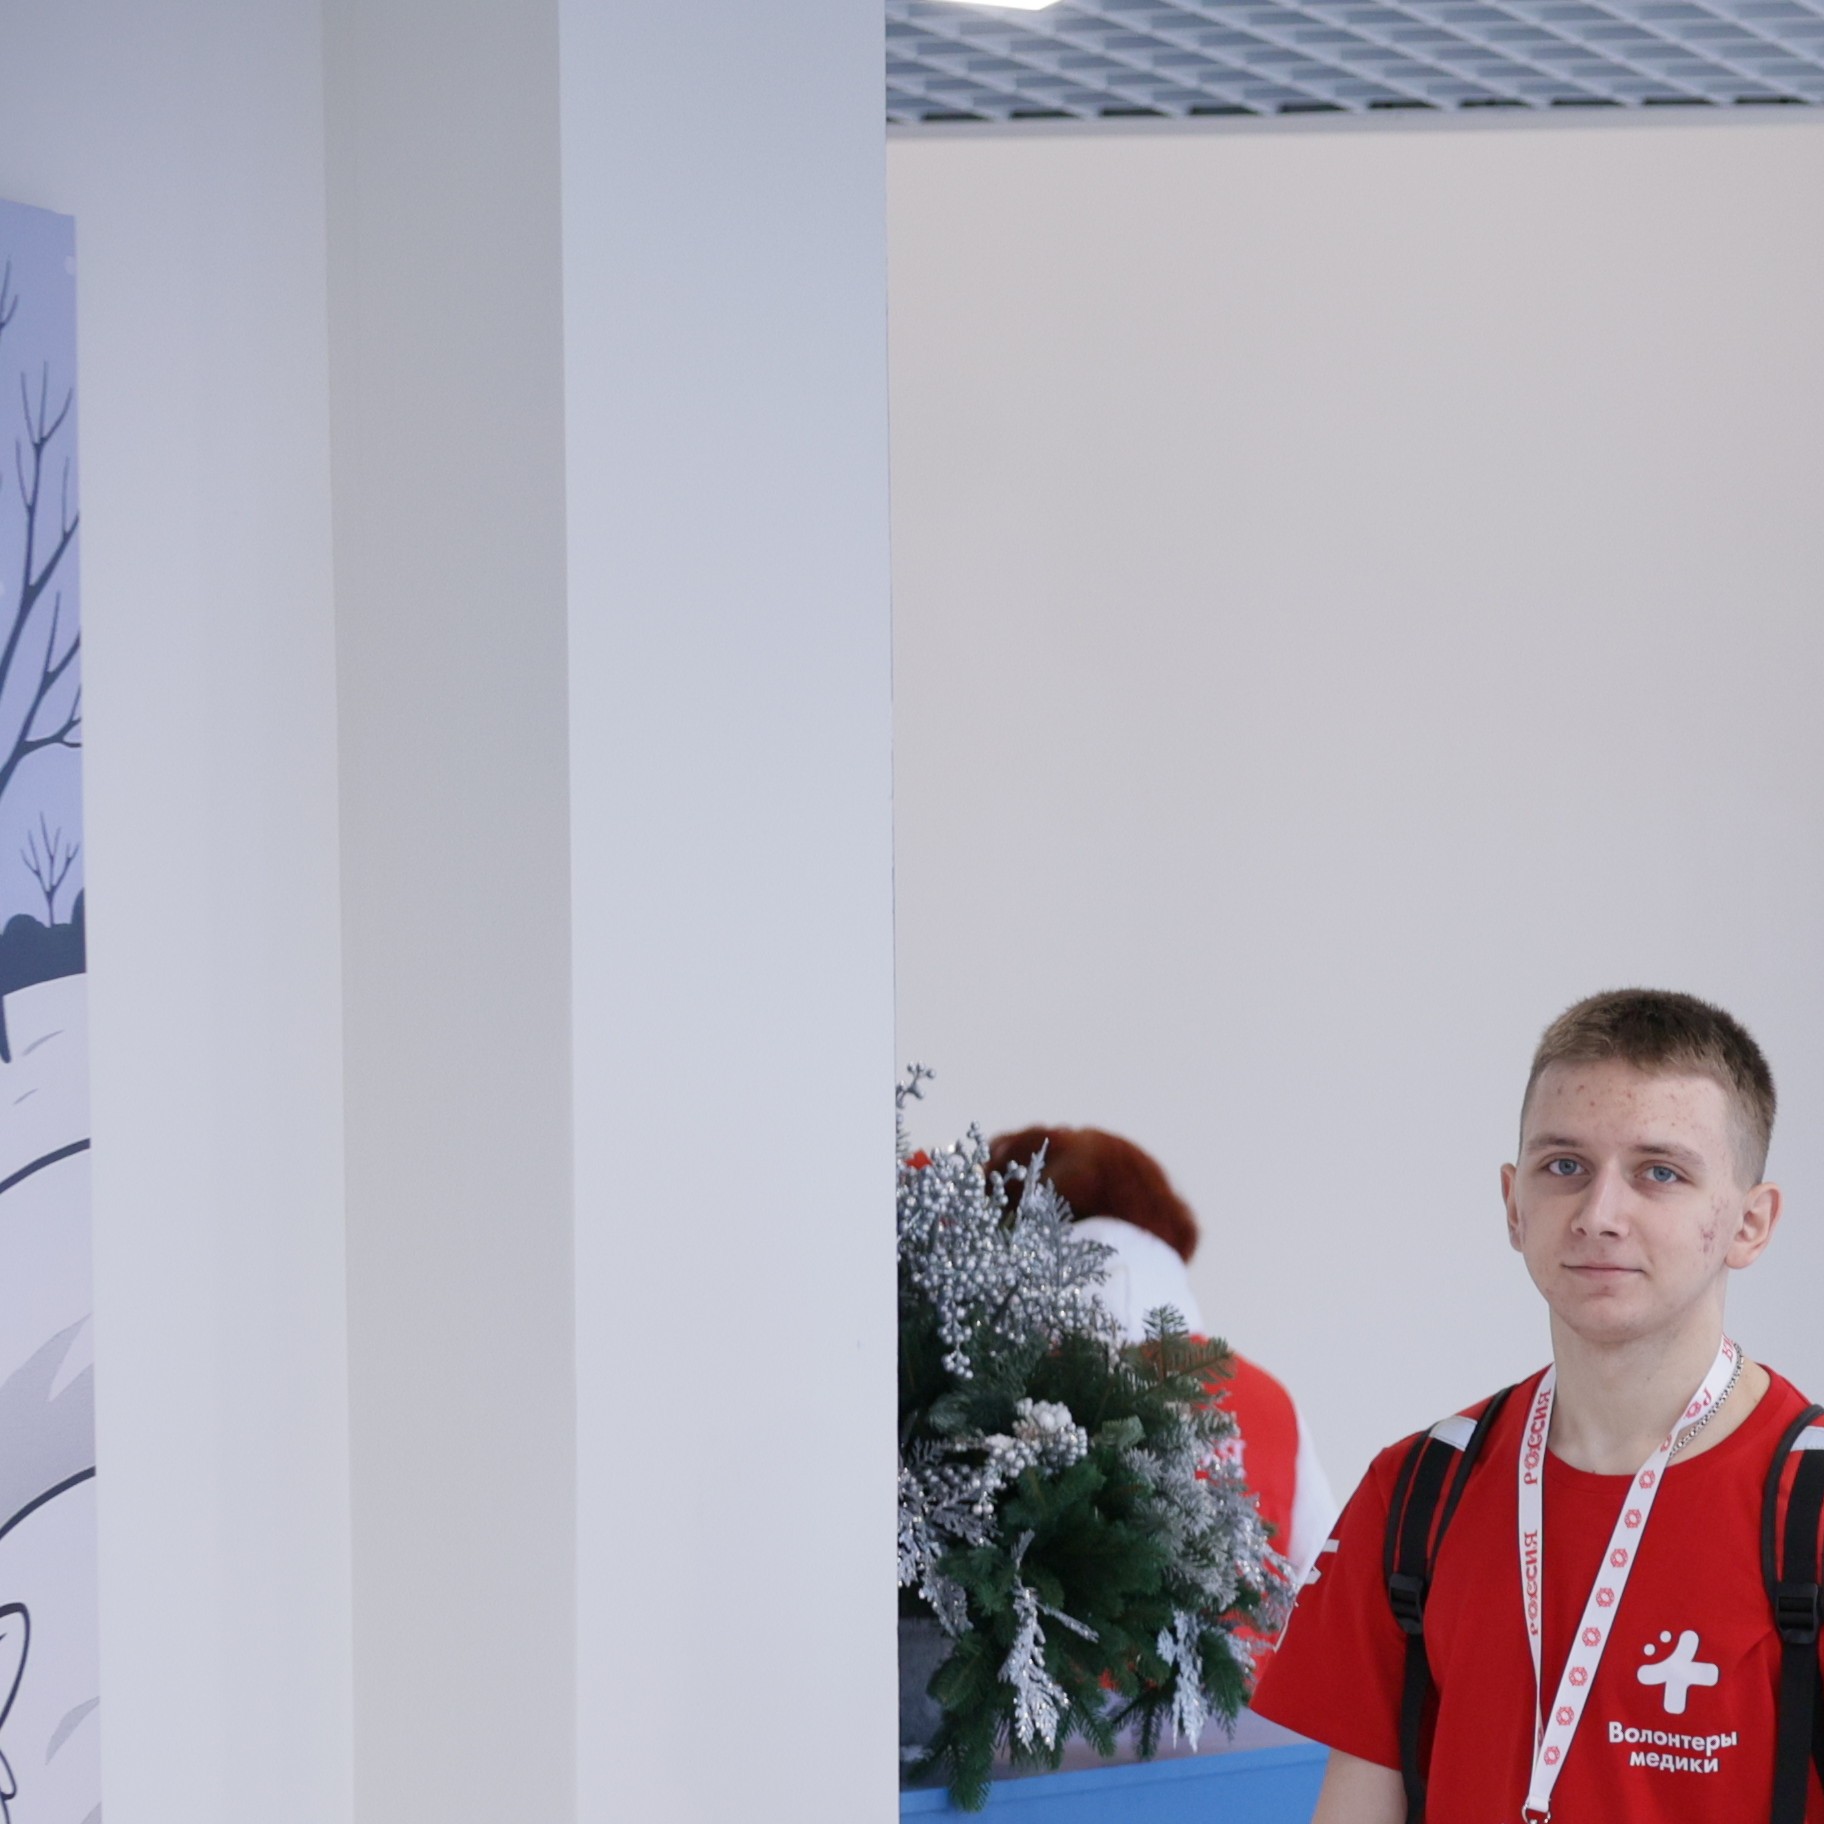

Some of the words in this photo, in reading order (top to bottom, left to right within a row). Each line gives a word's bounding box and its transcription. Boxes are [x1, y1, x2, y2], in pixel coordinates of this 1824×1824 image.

[1524, 1389, 1552, 1486] РОССИЯ
[1524, 1530, 1538, 1635] РОССИЯ
[1609, 1721, 1738, 1757] Волонтеры
[1629, 1751, 1719, 1773] медики
